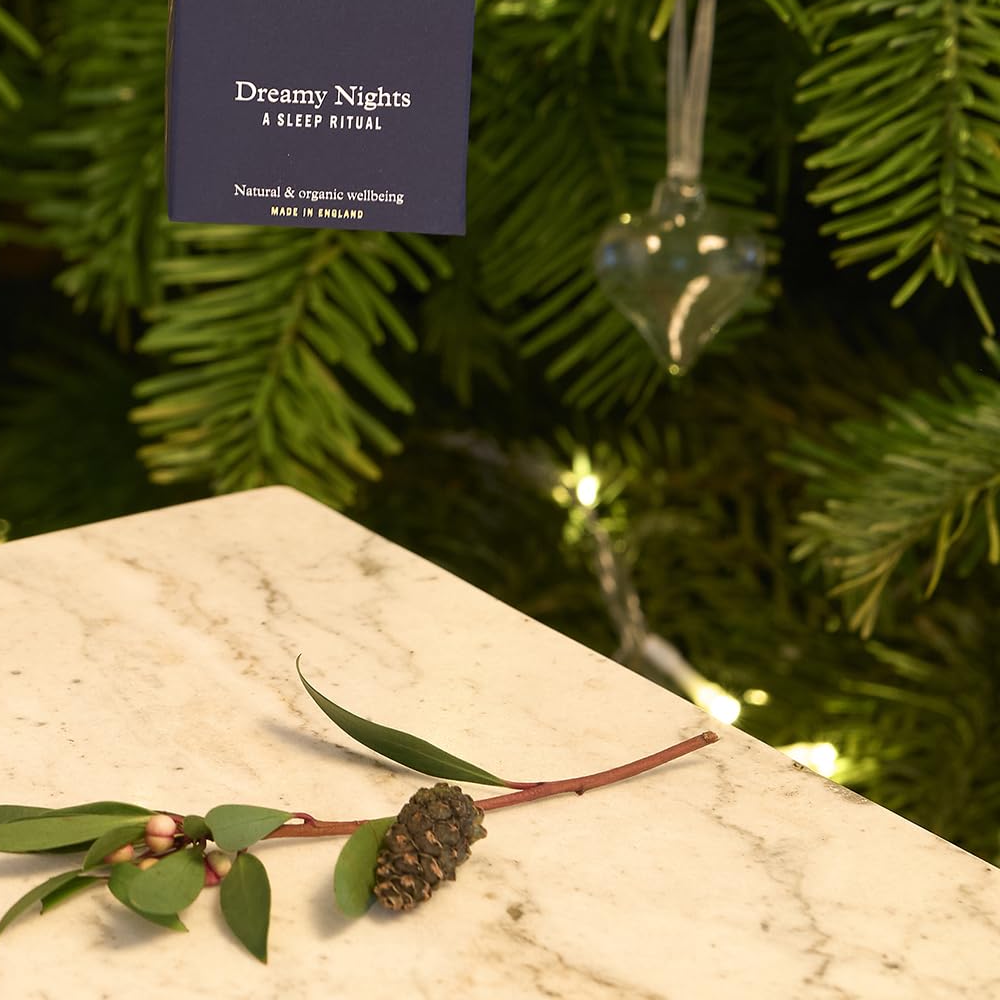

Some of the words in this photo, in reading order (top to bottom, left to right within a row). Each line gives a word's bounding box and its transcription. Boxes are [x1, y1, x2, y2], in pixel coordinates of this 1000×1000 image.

[235, 81, 328, 109] Dreamy
[334, 85, 411, 111] Nights
[262, 112, 270, 126] A
[277, 113, 323, 128] SLEEP
[330, 115, 382, 130] RITUAL
[234, 183, 281, 198] Natural
[284, 187, 295, 198] &
[298, 188, 344, 202] organic
[347, 189, 405, 204] wellbeing
[271, 206, 298, 217] MADE
[303, 208, 314, 217] IN
[318, 208, 364, 219] ENGLAND
